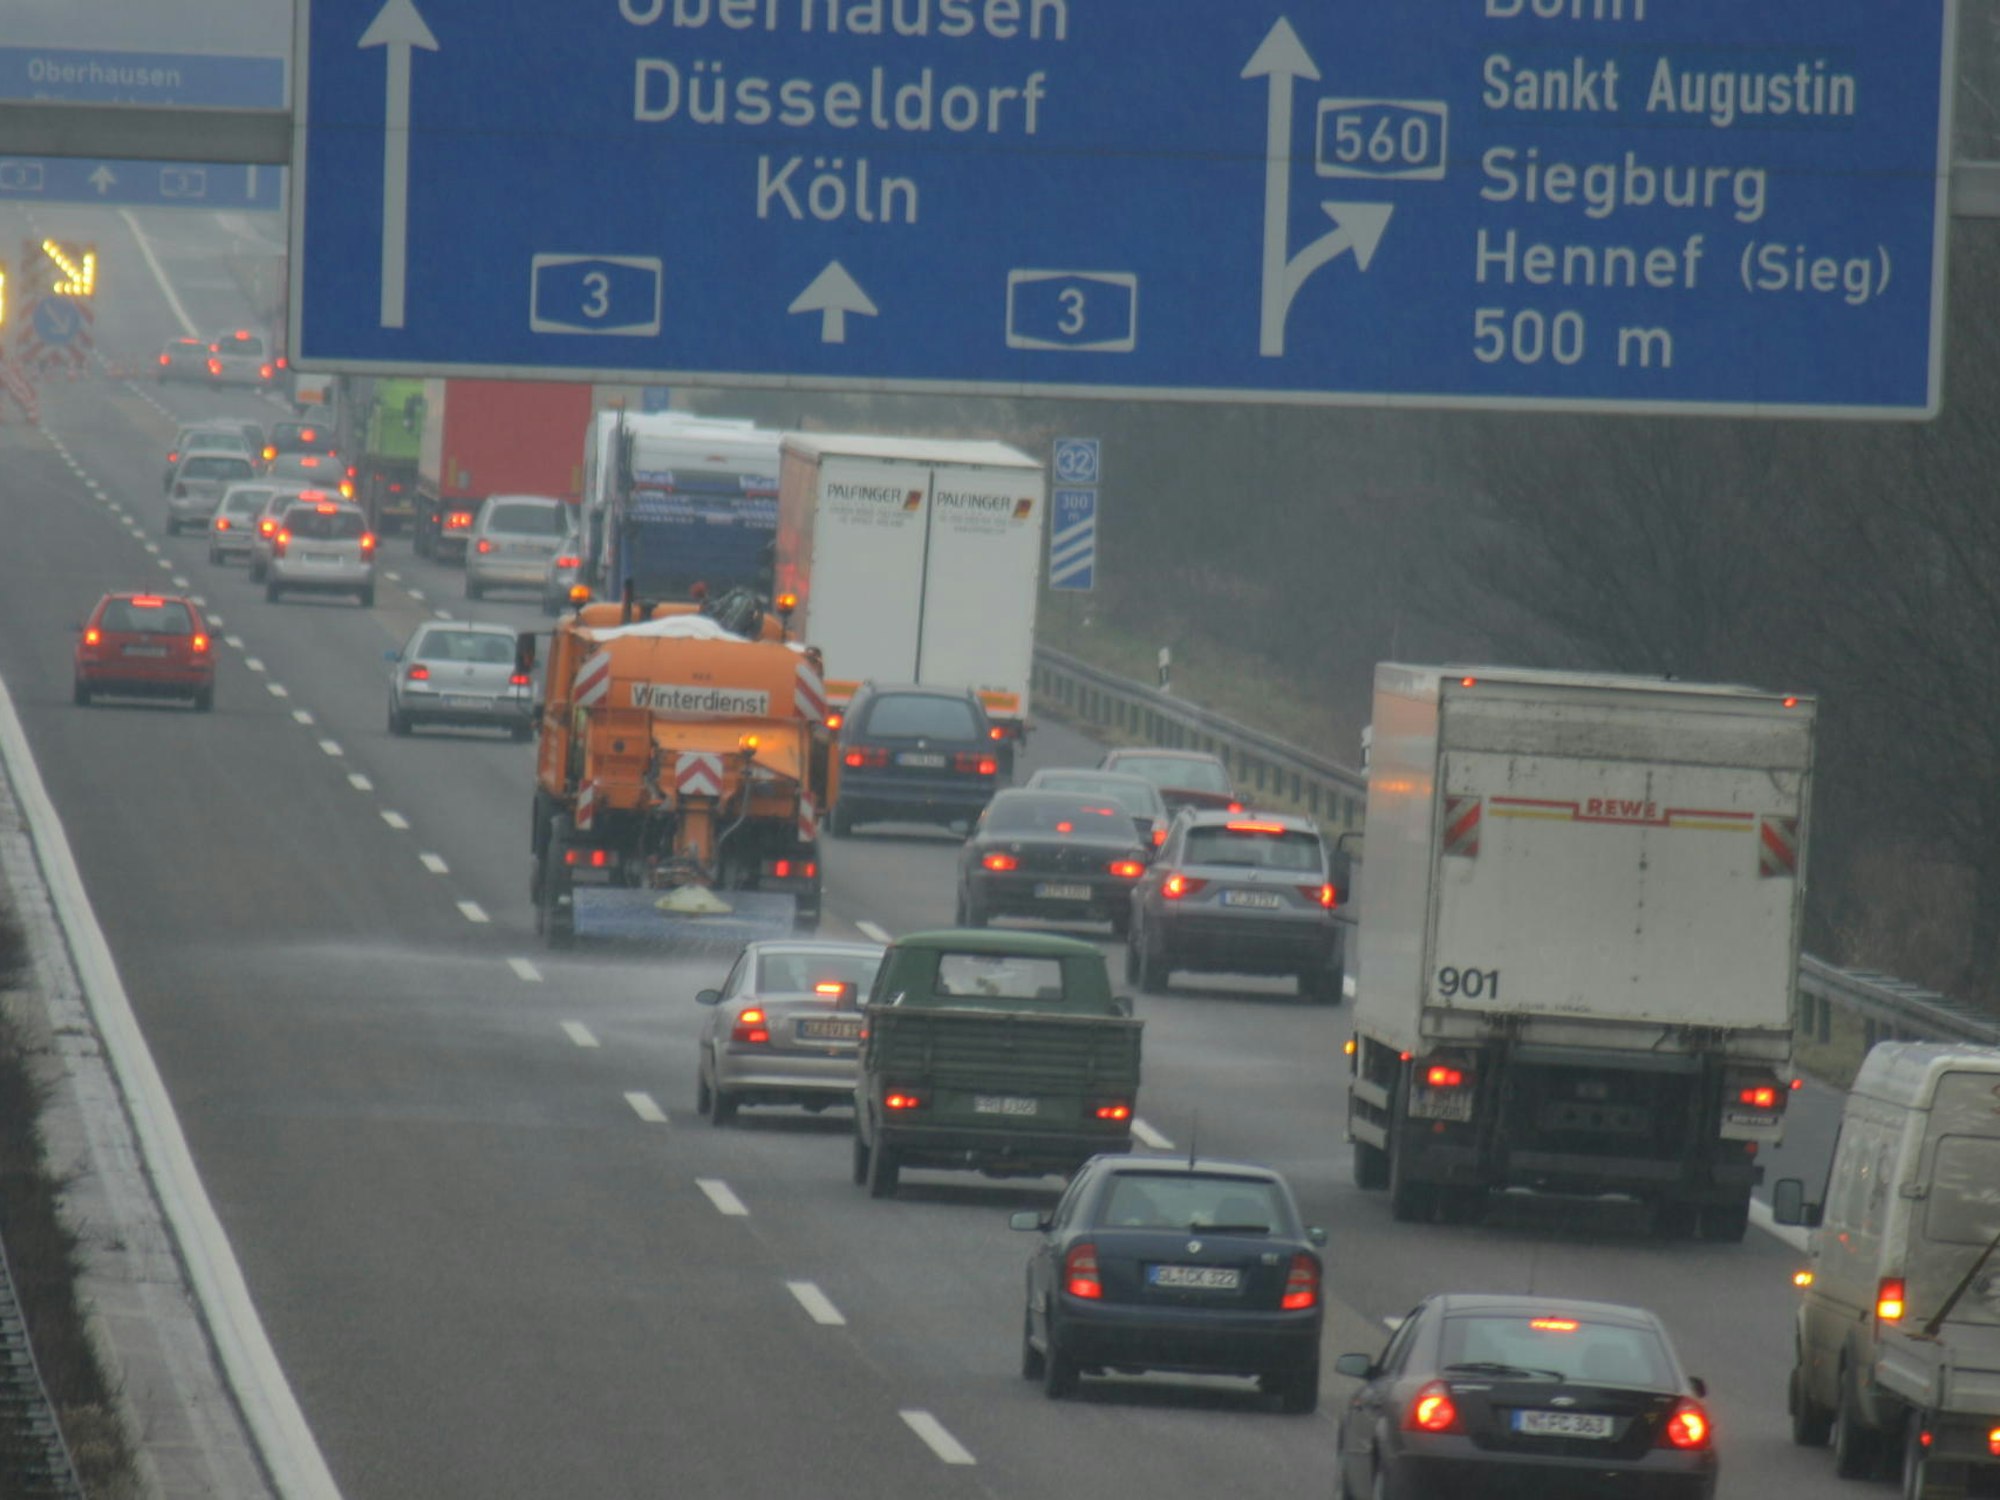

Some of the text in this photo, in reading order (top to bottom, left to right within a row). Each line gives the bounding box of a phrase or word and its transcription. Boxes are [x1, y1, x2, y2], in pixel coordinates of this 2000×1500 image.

[28, 58, 181, 87] Oberhausen
[1483, 54, 1855, 127] Sankt Augustin
[634, 59, 1046, 134] Düsseldorf
[1335, 116, 1429, 163] 560
[757, 156, 918, 223] Köln
[1480, 146, 1766, 223] Siegburg
[1475, 230, 1890, 305] Hennef (Sieg)
[582, 272, 610, 318] 3
[1058, 289, 1085, 334] 3
[1473, 309, 1672, 367] 500 m
[1062, 451, 1090, 474] 32
[827, 483, 902, 503] PALFINGER
[937, 490, 1011, 511] PALFINGER
[633, 685, 767, 714] Winterdienst
[1588, 797, 1657, 817] REWE
[1438, 966, 1498, 1000] 901
